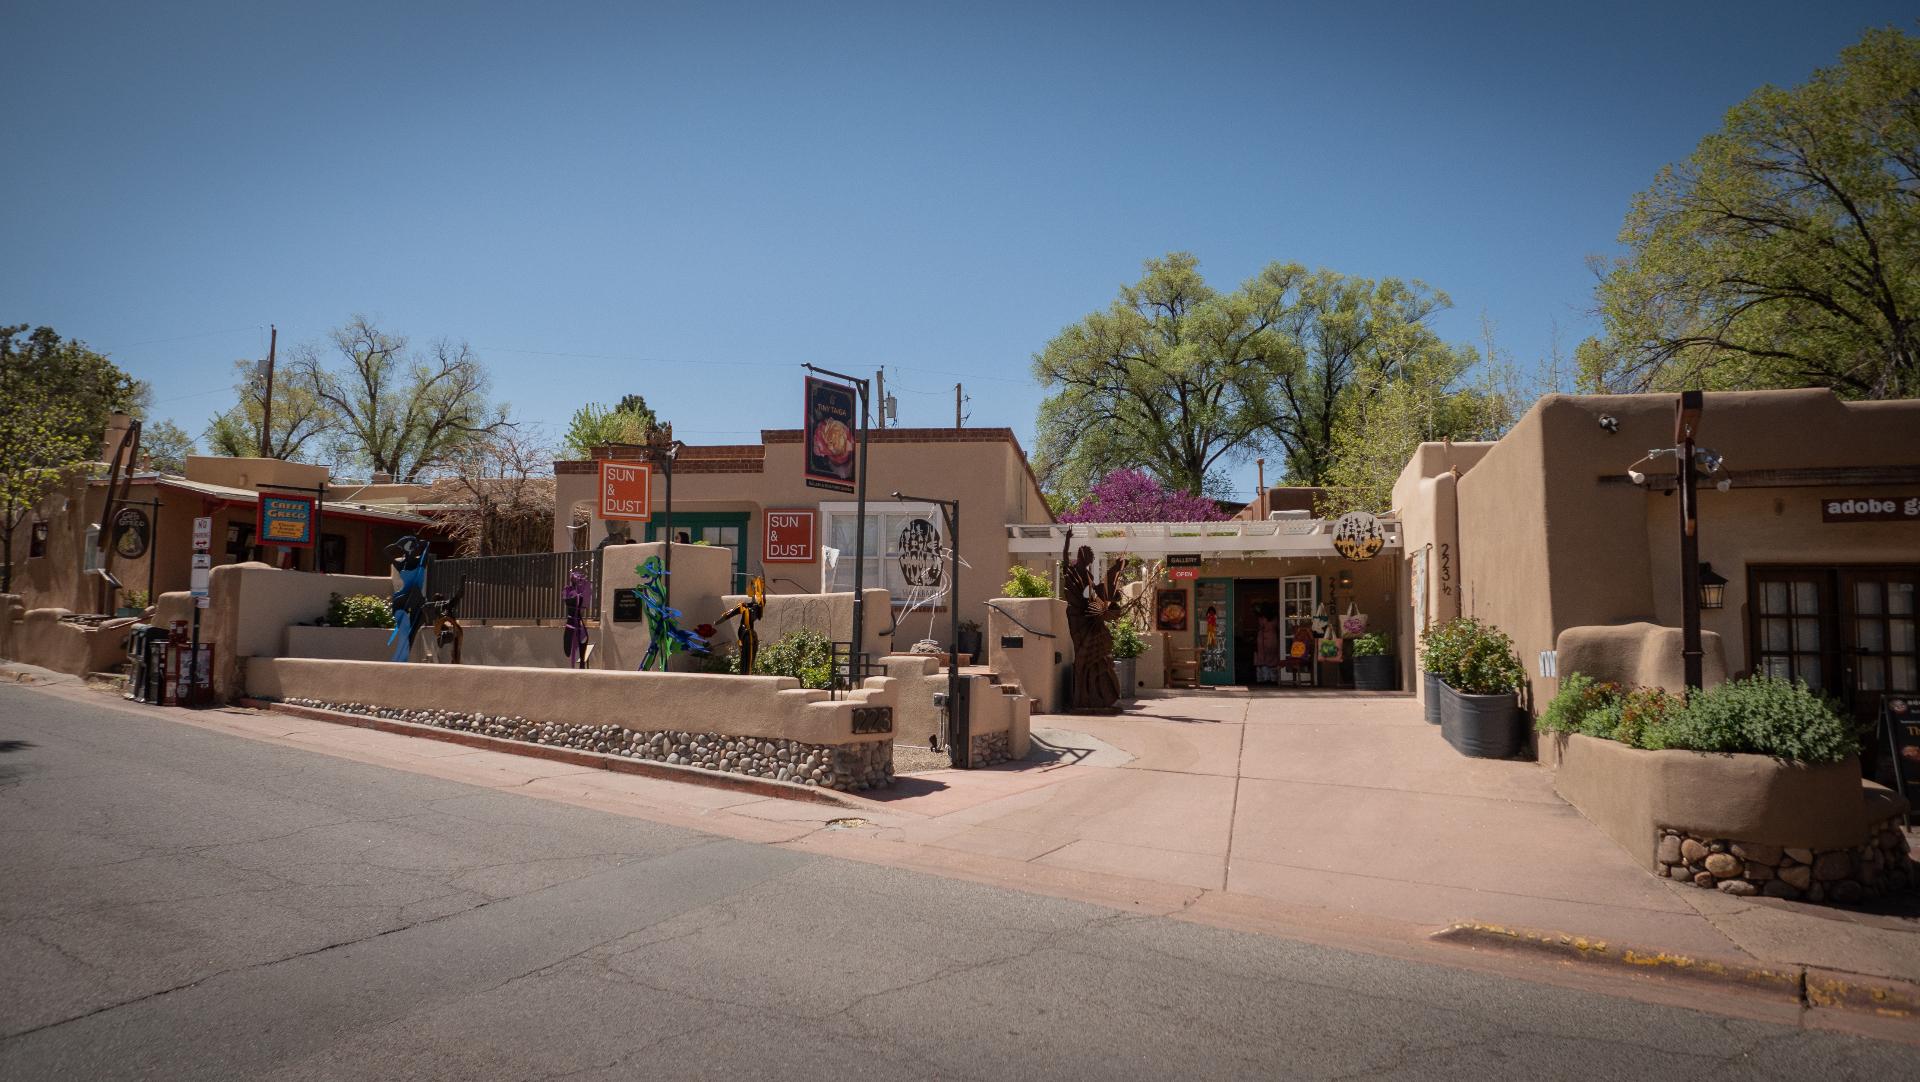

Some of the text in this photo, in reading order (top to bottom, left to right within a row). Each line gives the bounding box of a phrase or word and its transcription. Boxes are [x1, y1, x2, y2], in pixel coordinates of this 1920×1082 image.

[608, 468, 635, 482] SUN
[607, 483, 616, 496] &
[607, 498, 642, 513] DUST
[1828, 498, 1920, 516] adobe g
[771, 516, 799, 528] SUN
[770, 530, 778, 542] &
[770, 544, 807, 556] DUST
[855, 708, 891, 733] 223
